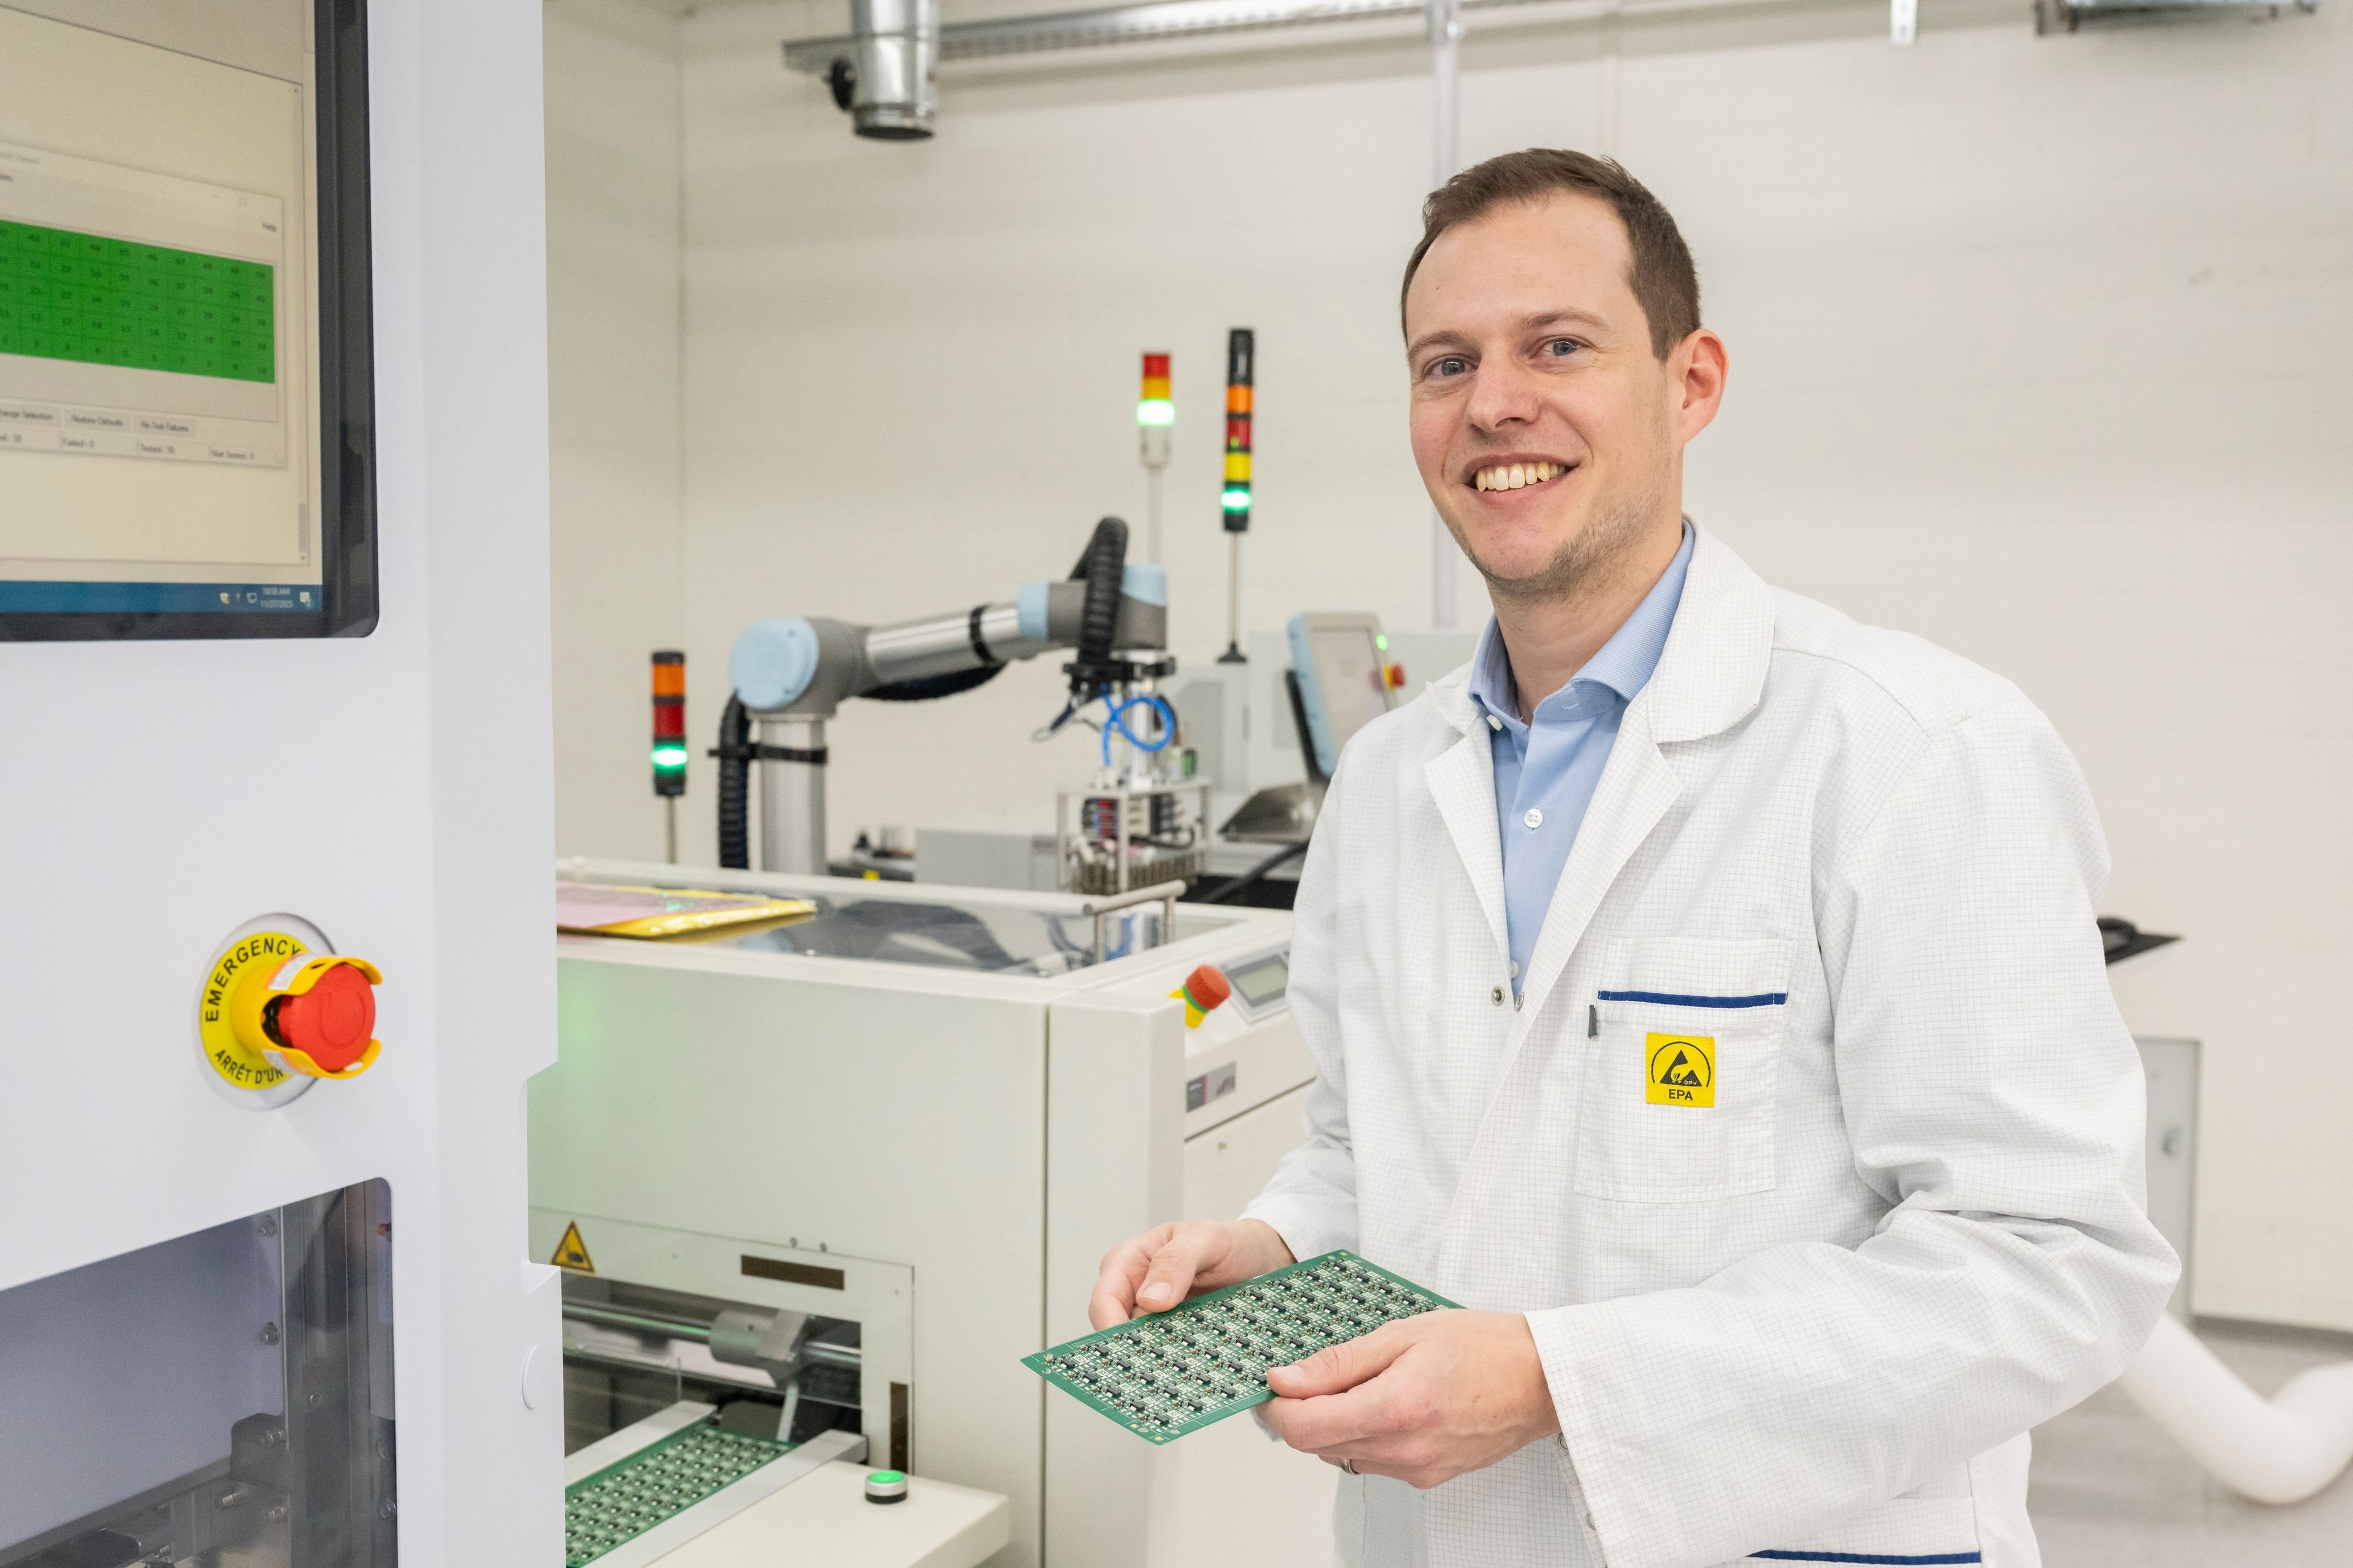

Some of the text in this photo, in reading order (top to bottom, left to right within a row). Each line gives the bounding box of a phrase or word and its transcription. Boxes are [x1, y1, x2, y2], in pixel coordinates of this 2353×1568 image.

[206, 938, 301, 1022] EMERGENCY
[215, 1049, 251, 1083] ARRÊT
[1668, 1088, 1694, 1101] EPA
